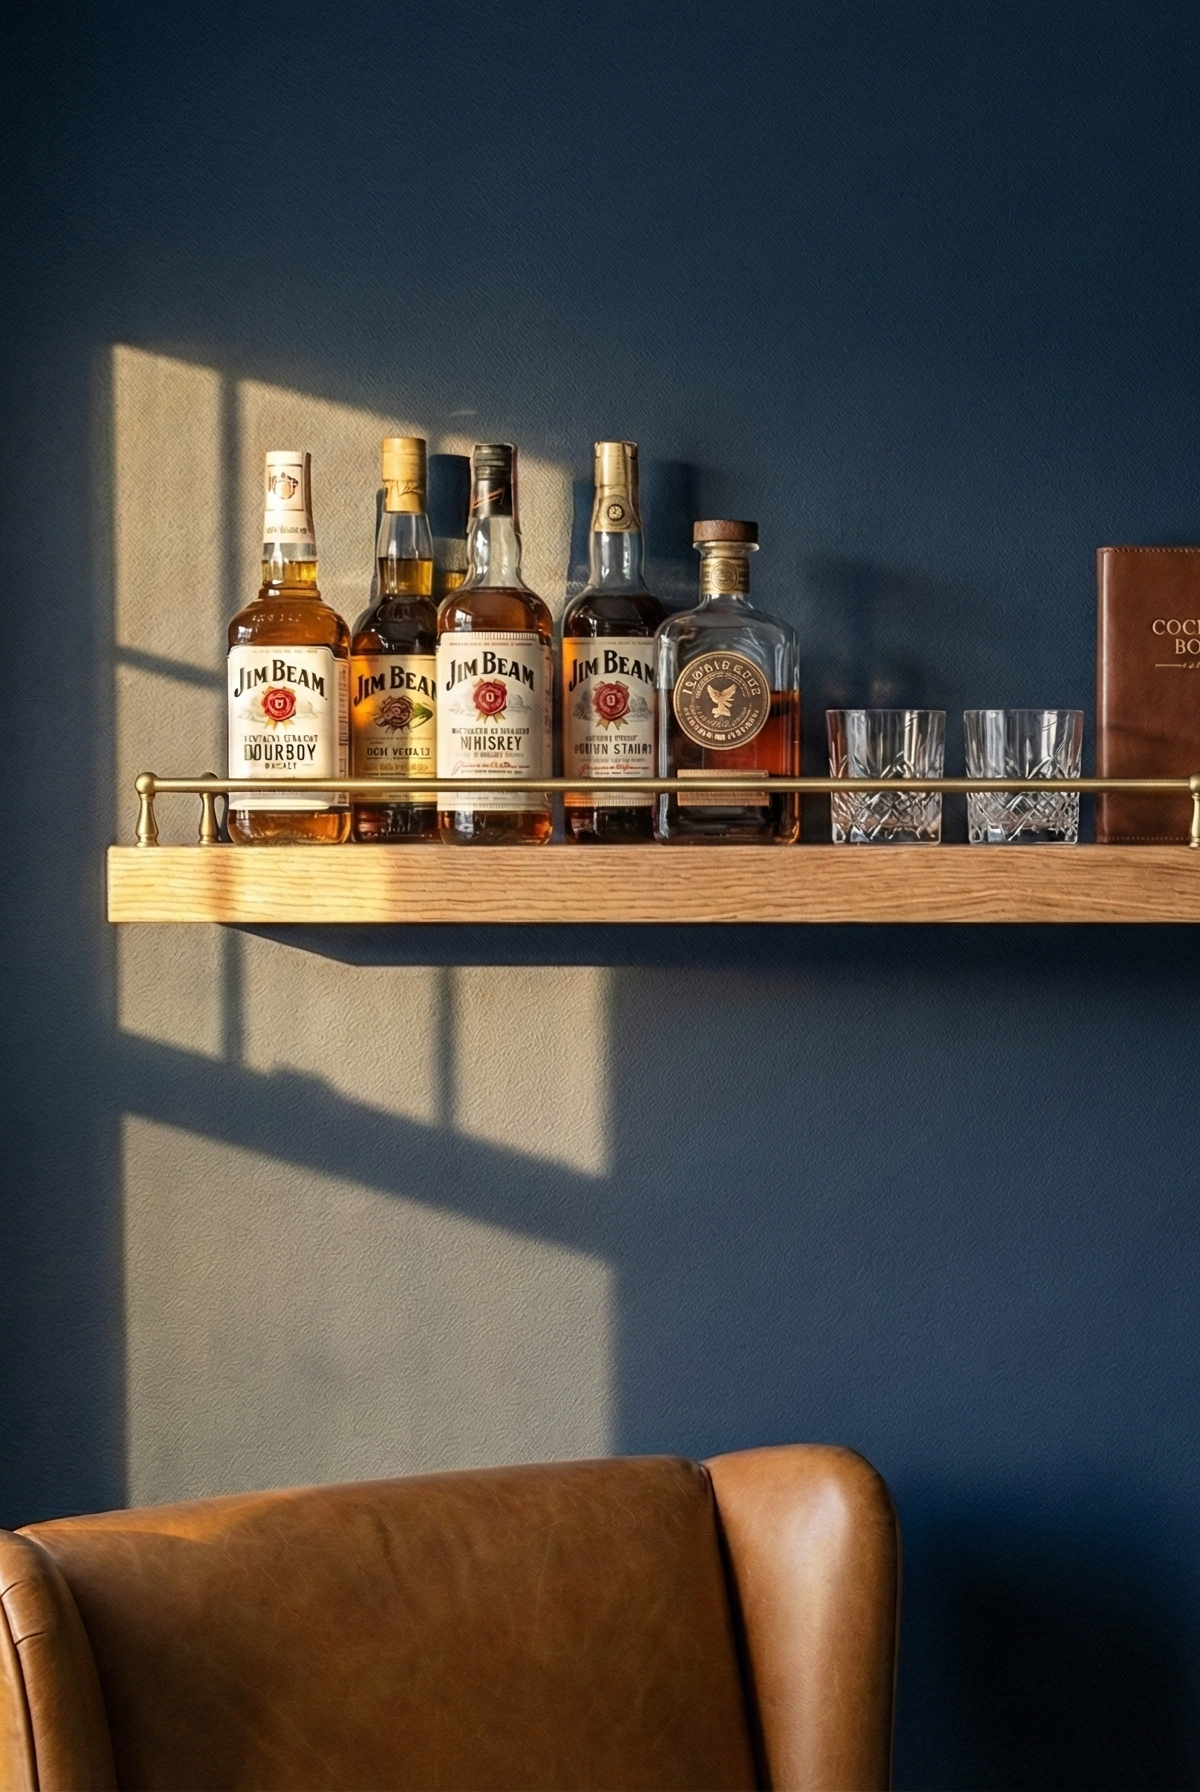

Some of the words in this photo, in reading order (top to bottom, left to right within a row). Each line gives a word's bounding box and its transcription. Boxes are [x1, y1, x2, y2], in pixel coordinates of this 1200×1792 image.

[234, 665, 268, 698] JIM
[272, 659, 326, 698] BEAM
[446, 658, 478, 692] JIM
[481, 651, 535, 692] BEAM
[569, 658, 599, 692] JIM
[353, 674, 386, 707] JIM
